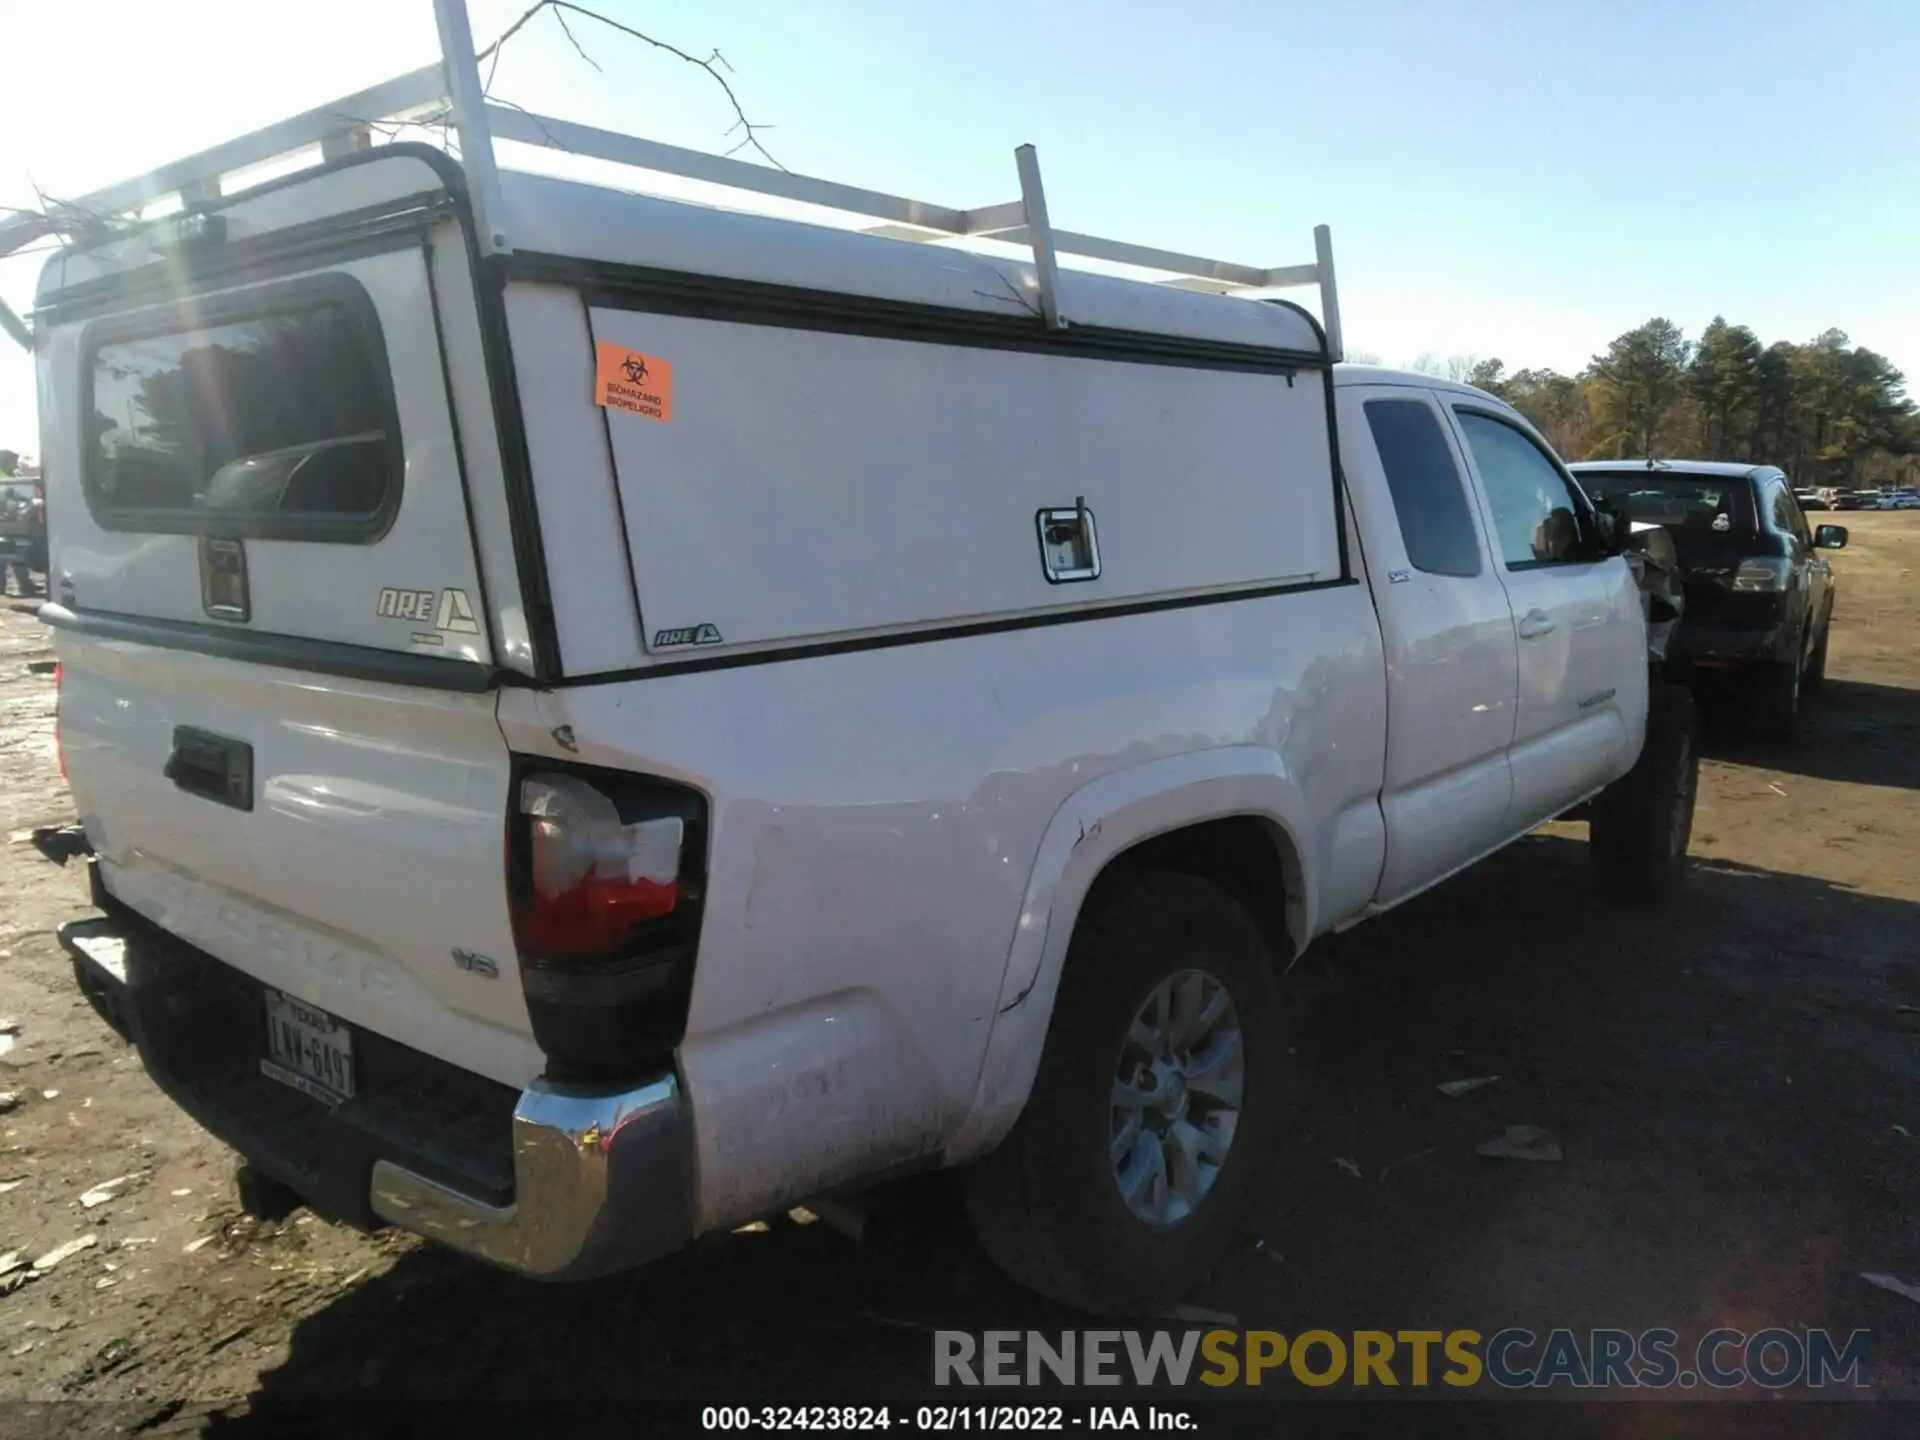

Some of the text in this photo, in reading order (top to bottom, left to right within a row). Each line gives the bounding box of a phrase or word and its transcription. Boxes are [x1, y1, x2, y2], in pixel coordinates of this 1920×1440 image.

[606, 394, 662, 418] BIOPELIGRO
[607, 382, 662, 406] BIOHAZARD
[451, 946, 500, 979] V6
